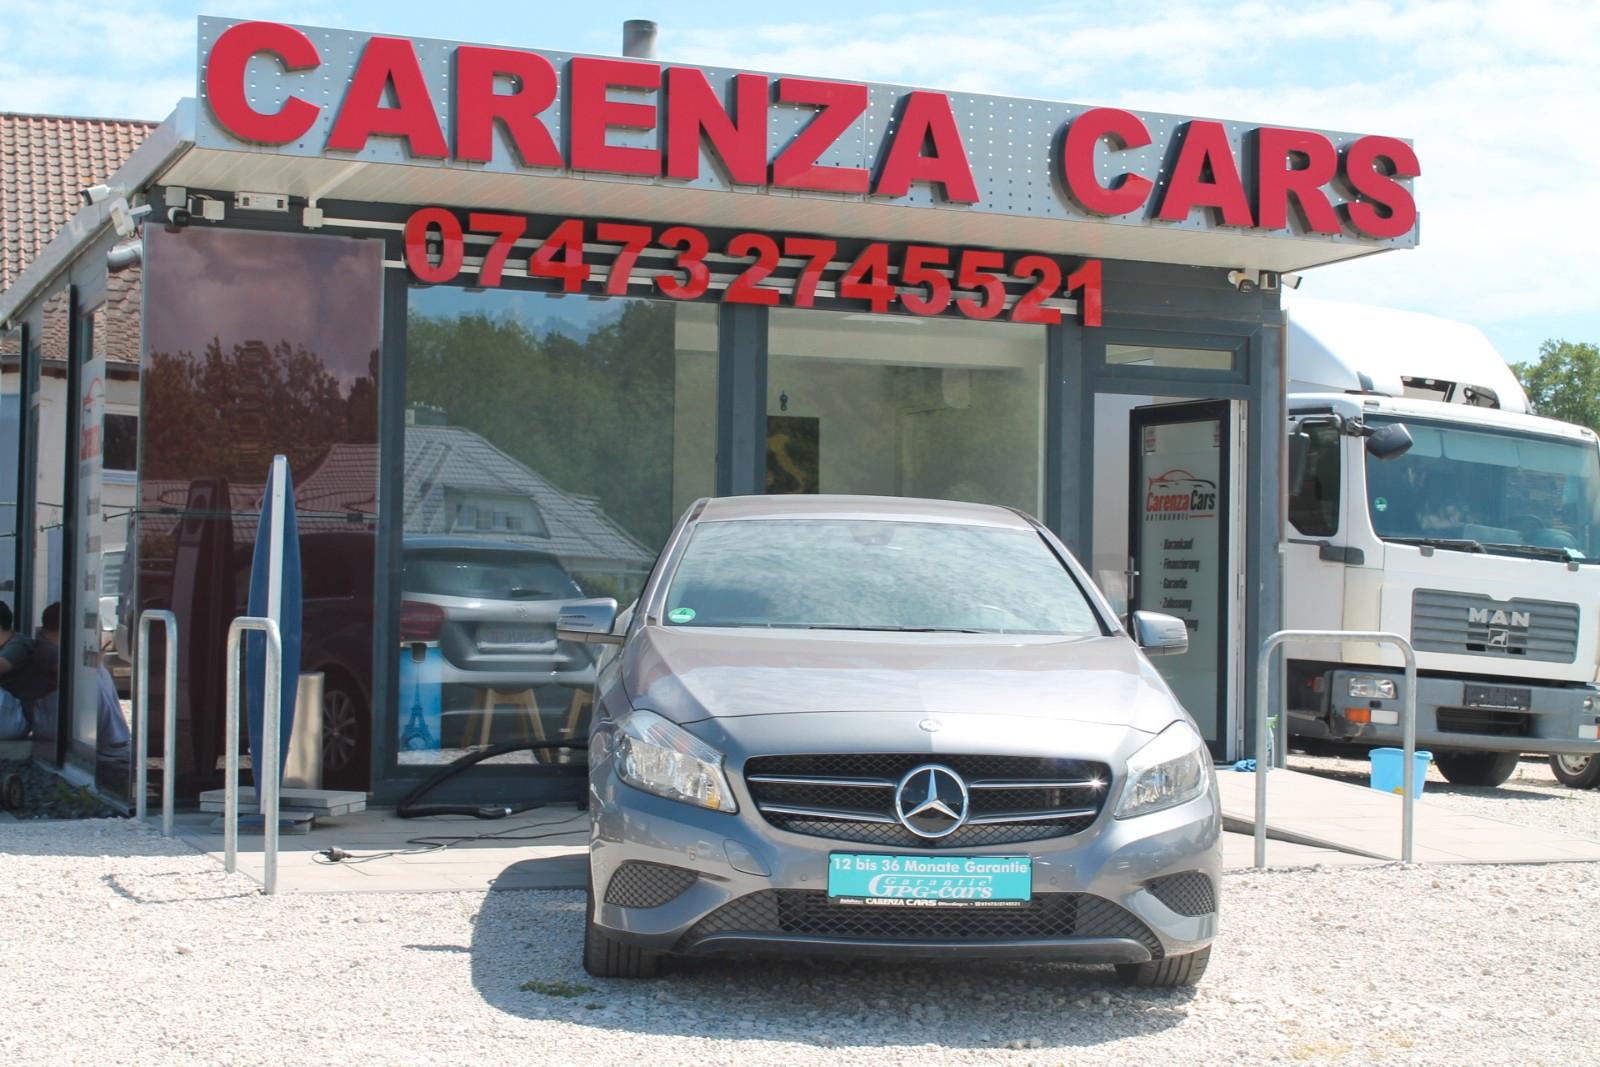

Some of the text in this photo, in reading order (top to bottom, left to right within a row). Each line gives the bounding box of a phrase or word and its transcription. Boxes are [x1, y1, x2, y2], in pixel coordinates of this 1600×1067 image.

[206, 22, 1421, 239] CARENZA CARS
[1163, 577, 1188, 589] Garantie
[1468, 607, 1531, 628] MAN
[834, 858, 1028, 874] 12 bis 36 Monate Garantie
[865, 898, 905, 906] CARENZA
[905, 899, 937, 907] CARS
